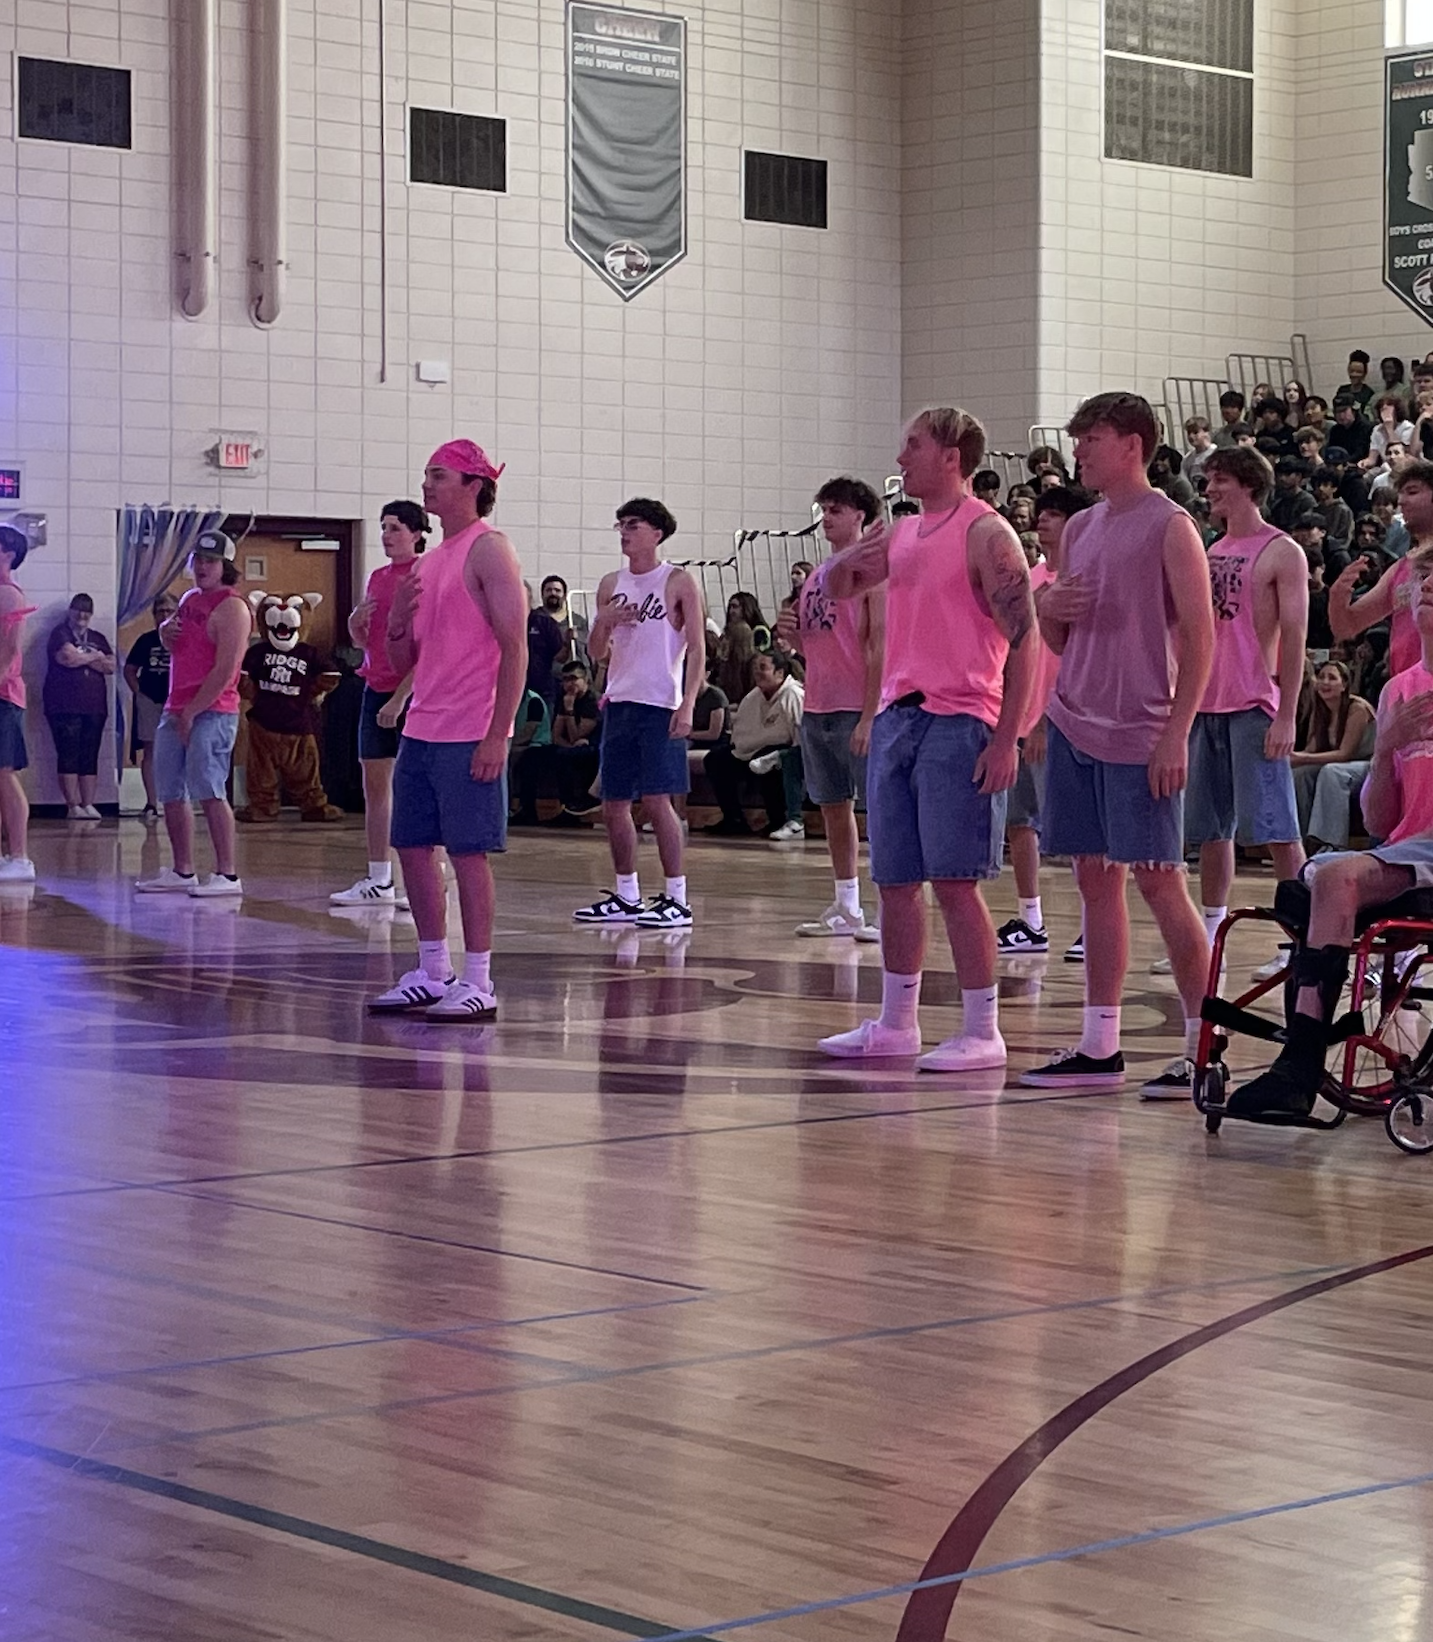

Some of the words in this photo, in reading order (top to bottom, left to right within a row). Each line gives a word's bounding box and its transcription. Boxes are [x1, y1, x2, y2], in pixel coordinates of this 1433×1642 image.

[1394, 254, 1429, 268] SCOTT
[225, 443, 250, 465] EXIT
[610, 592, 668, 623] Bbie
[263, 653, 307, 675] RIDGE
